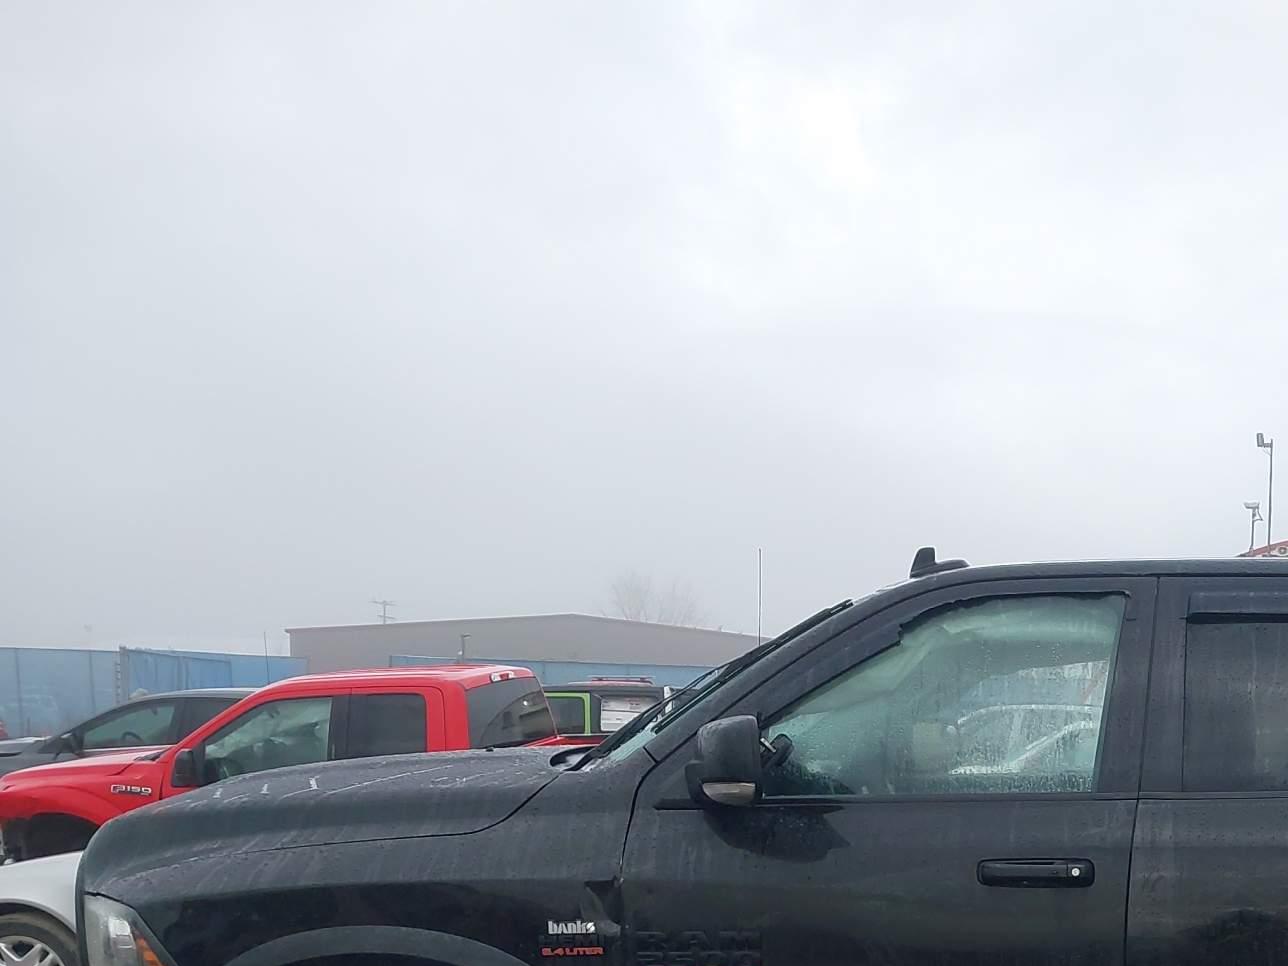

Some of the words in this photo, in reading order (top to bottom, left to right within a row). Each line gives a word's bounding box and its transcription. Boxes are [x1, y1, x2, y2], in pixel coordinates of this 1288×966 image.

[547, 919, 596, 934] banks
[636, 930, 761, 951] RAM
[565, 946, 604, 956] LITER
